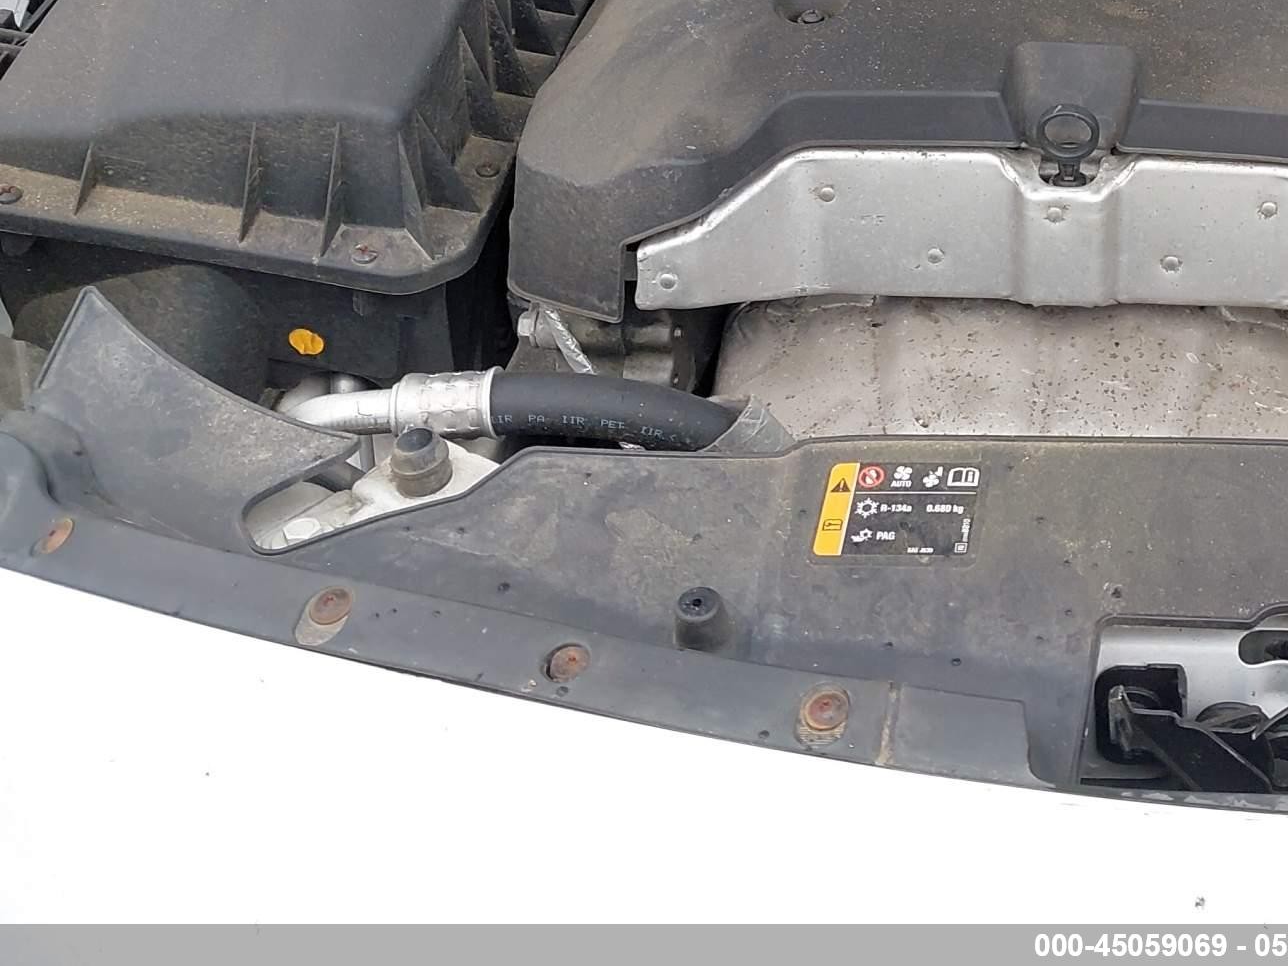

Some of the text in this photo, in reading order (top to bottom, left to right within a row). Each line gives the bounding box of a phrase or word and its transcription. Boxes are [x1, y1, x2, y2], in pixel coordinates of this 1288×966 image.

[528, 414, 545, 423] PA
[890, 480, 912, 488] AUTO
[880, 503, 913, 513] R-134a
[952, 504, 964, 515] kg
[876, 531, 896, 541] PAG
